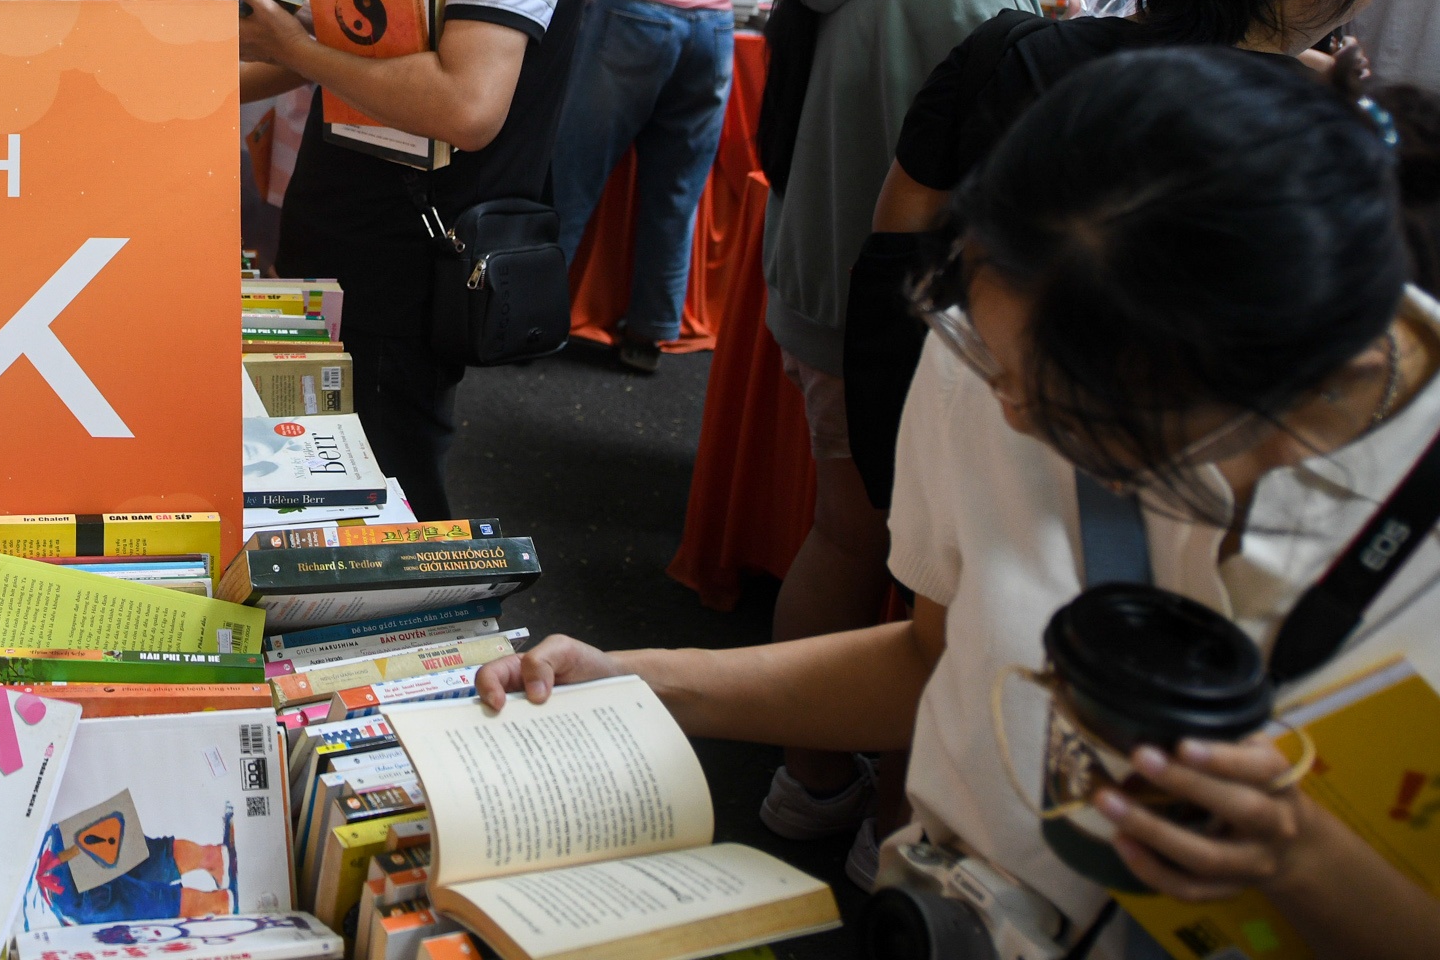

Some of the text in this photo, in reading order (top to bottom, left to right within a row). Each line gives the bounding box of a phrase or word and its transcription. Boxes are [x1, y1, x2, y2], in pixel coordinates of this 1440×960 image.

[309, 432, 348, 477] Berr
[263, 494, 300, 505] Hélène
[302, 494, 325, 504] Berr
[1362, 518, 1411, 571] EOS
[416, 549, 451, 562] NGƯỜI
[452, 546, 490, 560] KHỔNG
[297, 559, 384, 573] Richard S. Tedlow
[419, 560, 443, 573] GIỚI
[444, 561, 470, 572] KINH
[471, 559, 508, 571] DOANH
[363, 623, 377, 633] báo
[379, 622, 398, 633] giới
[399, 617, 421, 628] trích
[422, 614, 439, 624] dẫn
[454, 608, 470, 619] bạn
[296, 647, 317, 656] GIICHI
[319, 641, 359, 652] MARUSHIMA
[380, 633, 397, 644] BẢN
[398, 629, 427, 642] QUYỀN
[442, 653, 464, 667] NAM
